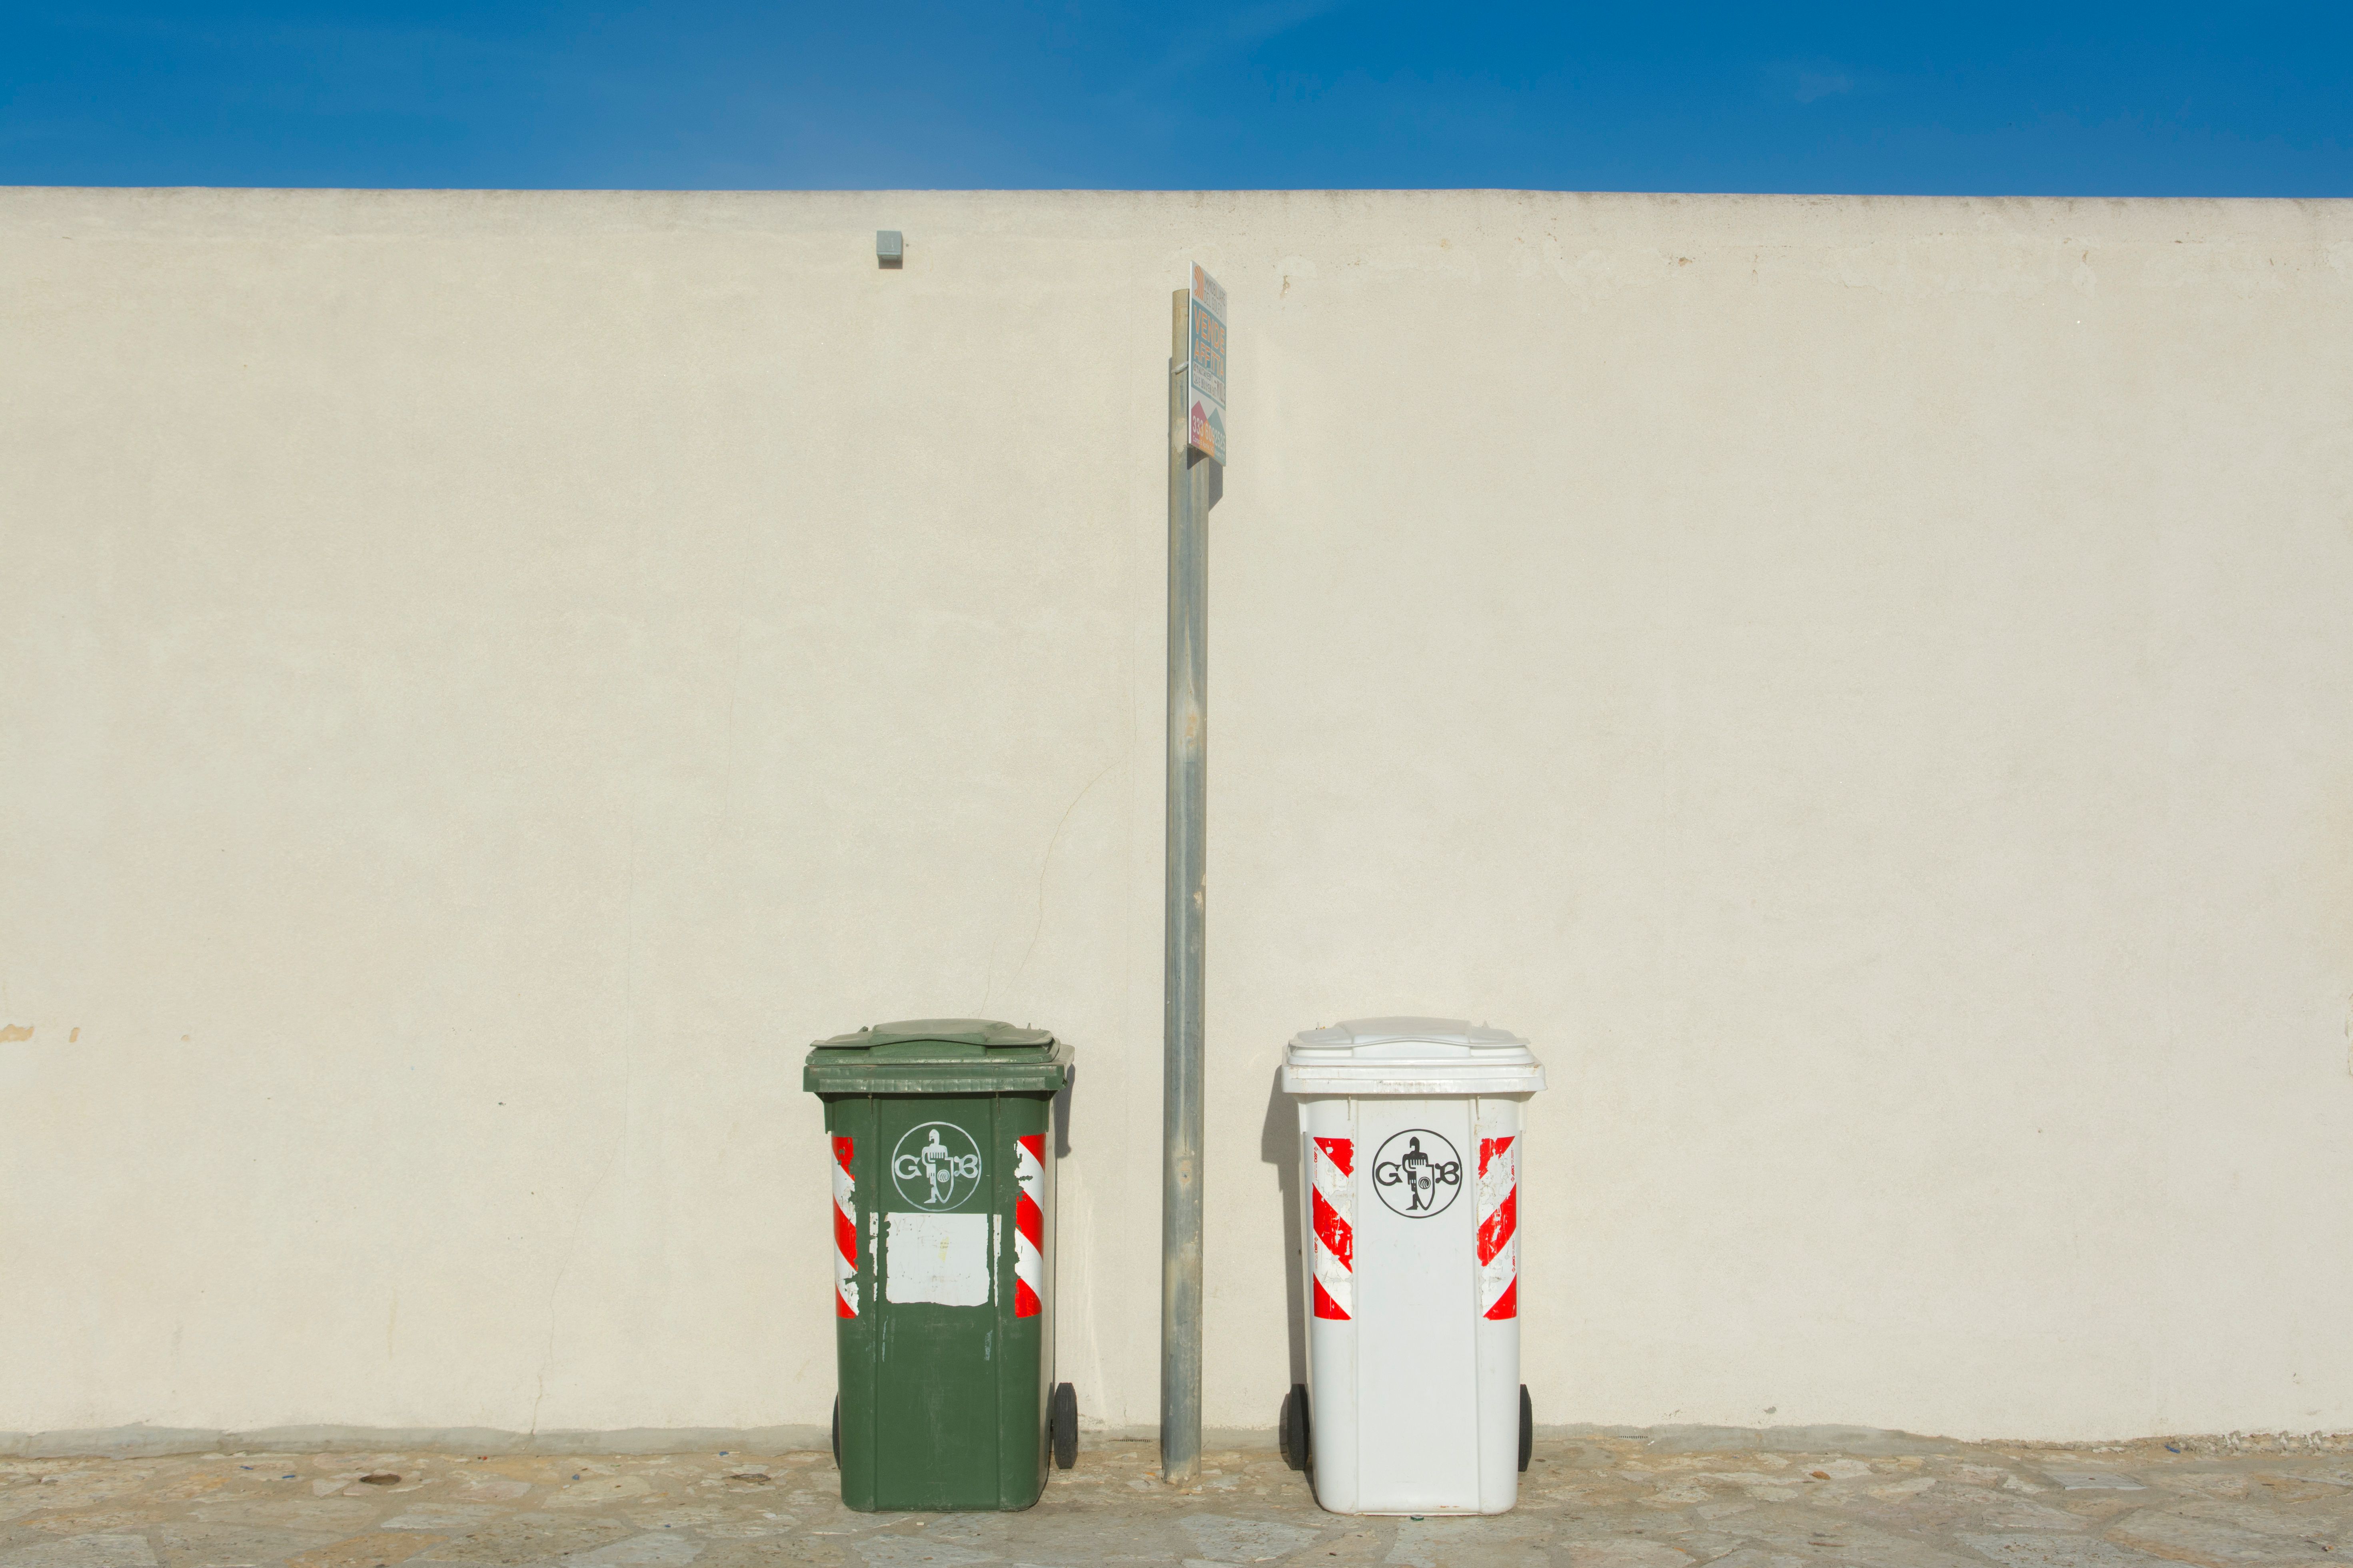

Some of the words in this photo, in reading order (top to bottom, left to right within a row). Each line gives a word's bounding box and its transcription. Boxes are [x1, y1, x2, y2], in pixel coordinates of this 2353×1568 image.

[1204, 274, 1226, 307] IMMOBILIARE
[1212, 297, 1222, 317] GOLFO
[1194, 305, 1225, 355] VENDE
[1194, 338, 1224, 381] AFFITTA
[1192, 415, 1203, 437] 333
[1205, 423, 1226, 452] 6092525
